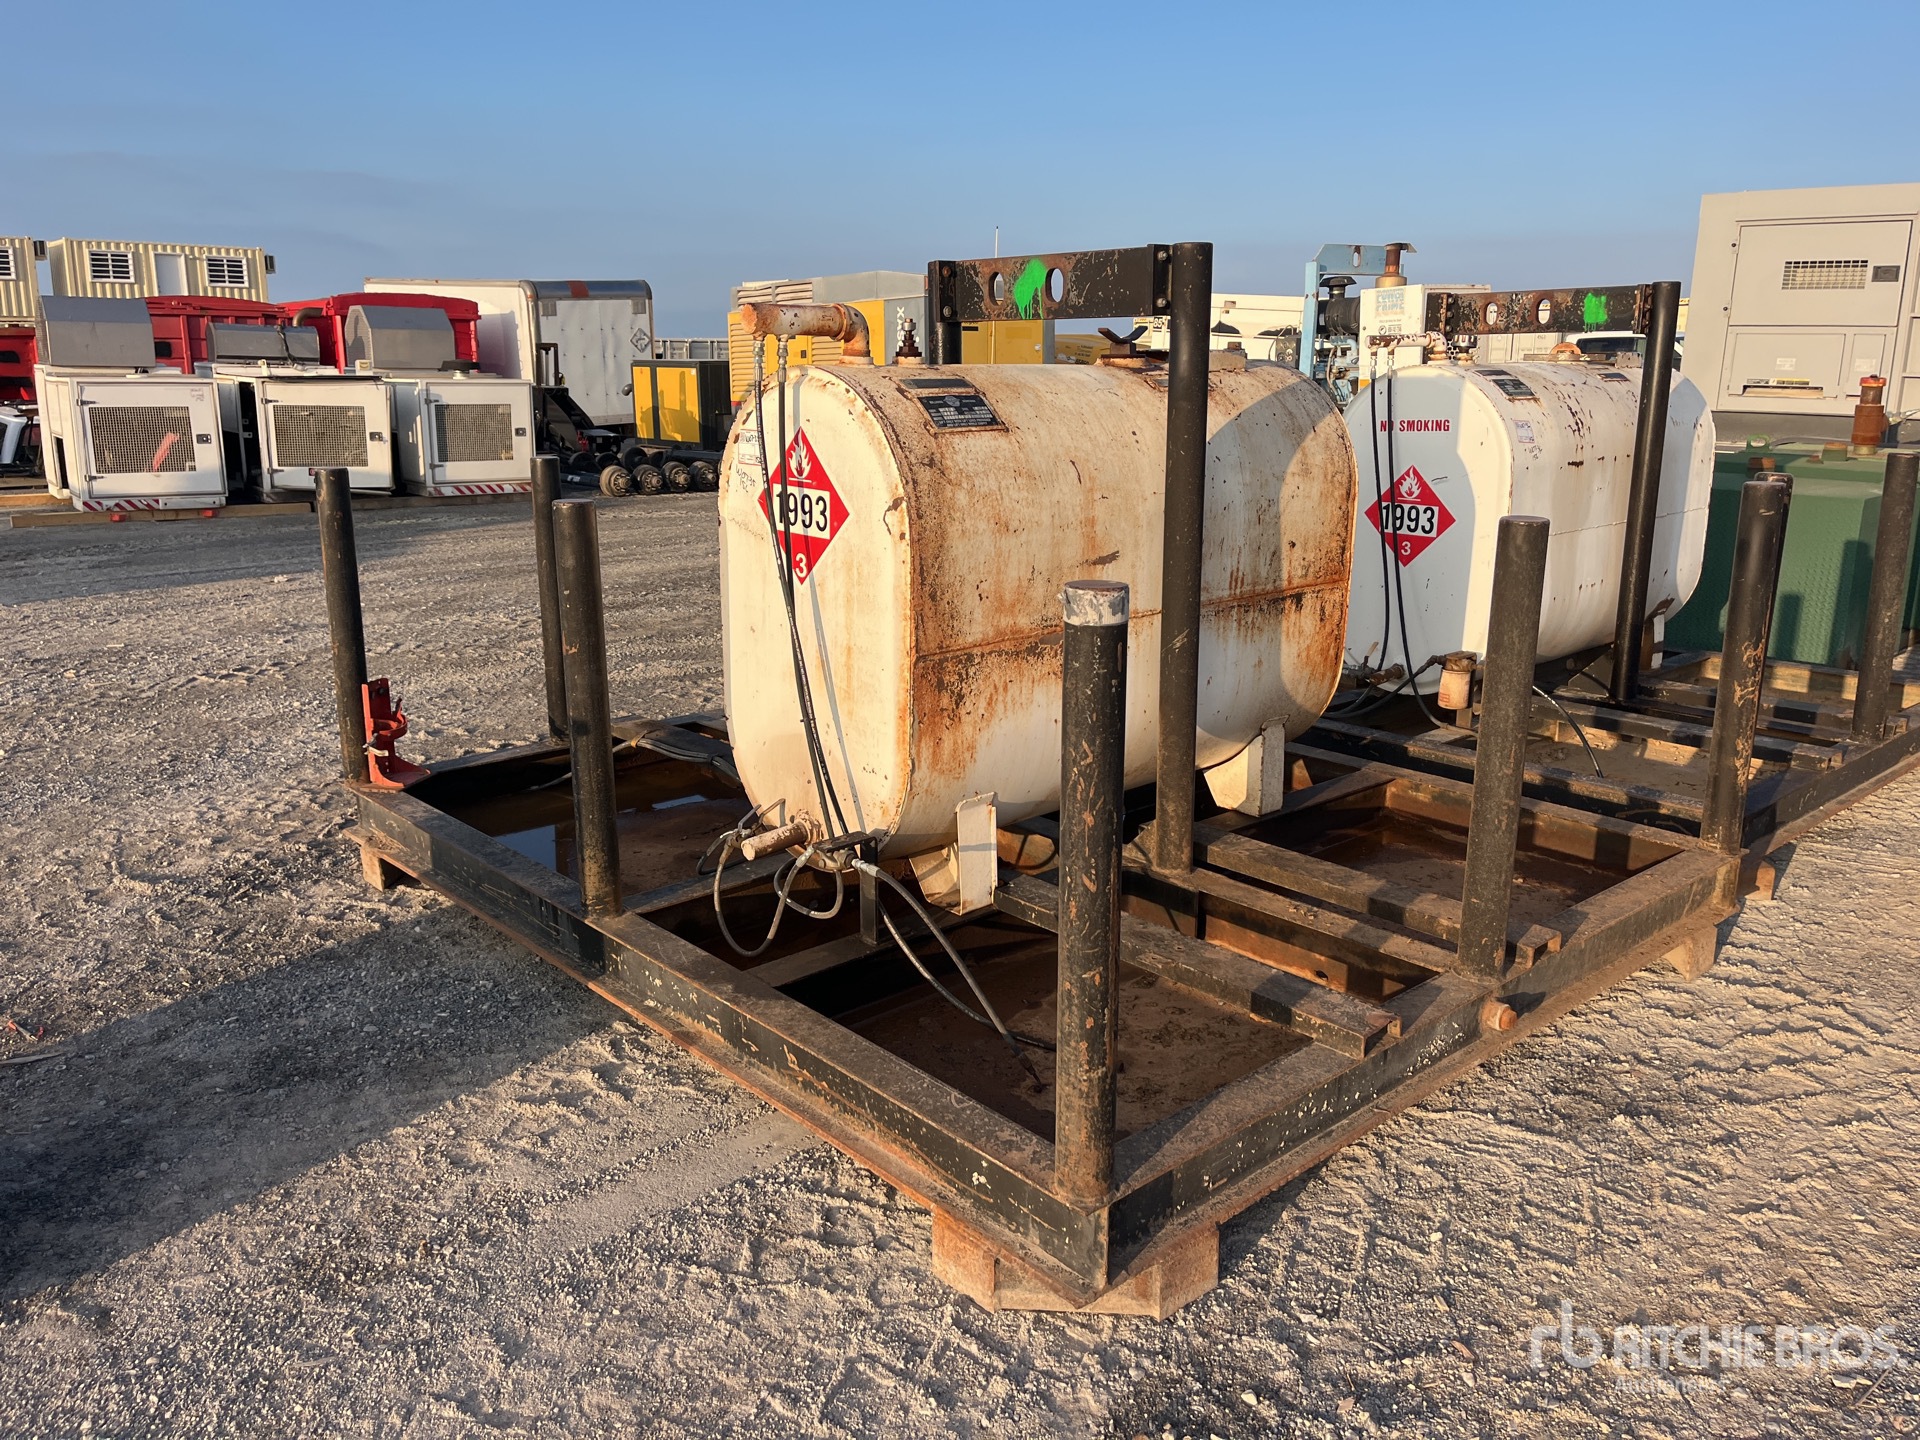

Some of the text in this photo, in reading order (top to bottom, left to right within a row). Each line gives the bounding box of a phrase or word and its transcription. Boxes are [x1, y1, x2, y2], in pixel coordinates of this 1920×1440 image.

[1399, 419, 1450, 432] SMOKING
[776, 490, 828, 532] 1993
[1382, 503, 1435, 535] 1993
[1401, 541, 1411, 555] 3
[795, 552, 807, 578] 3
